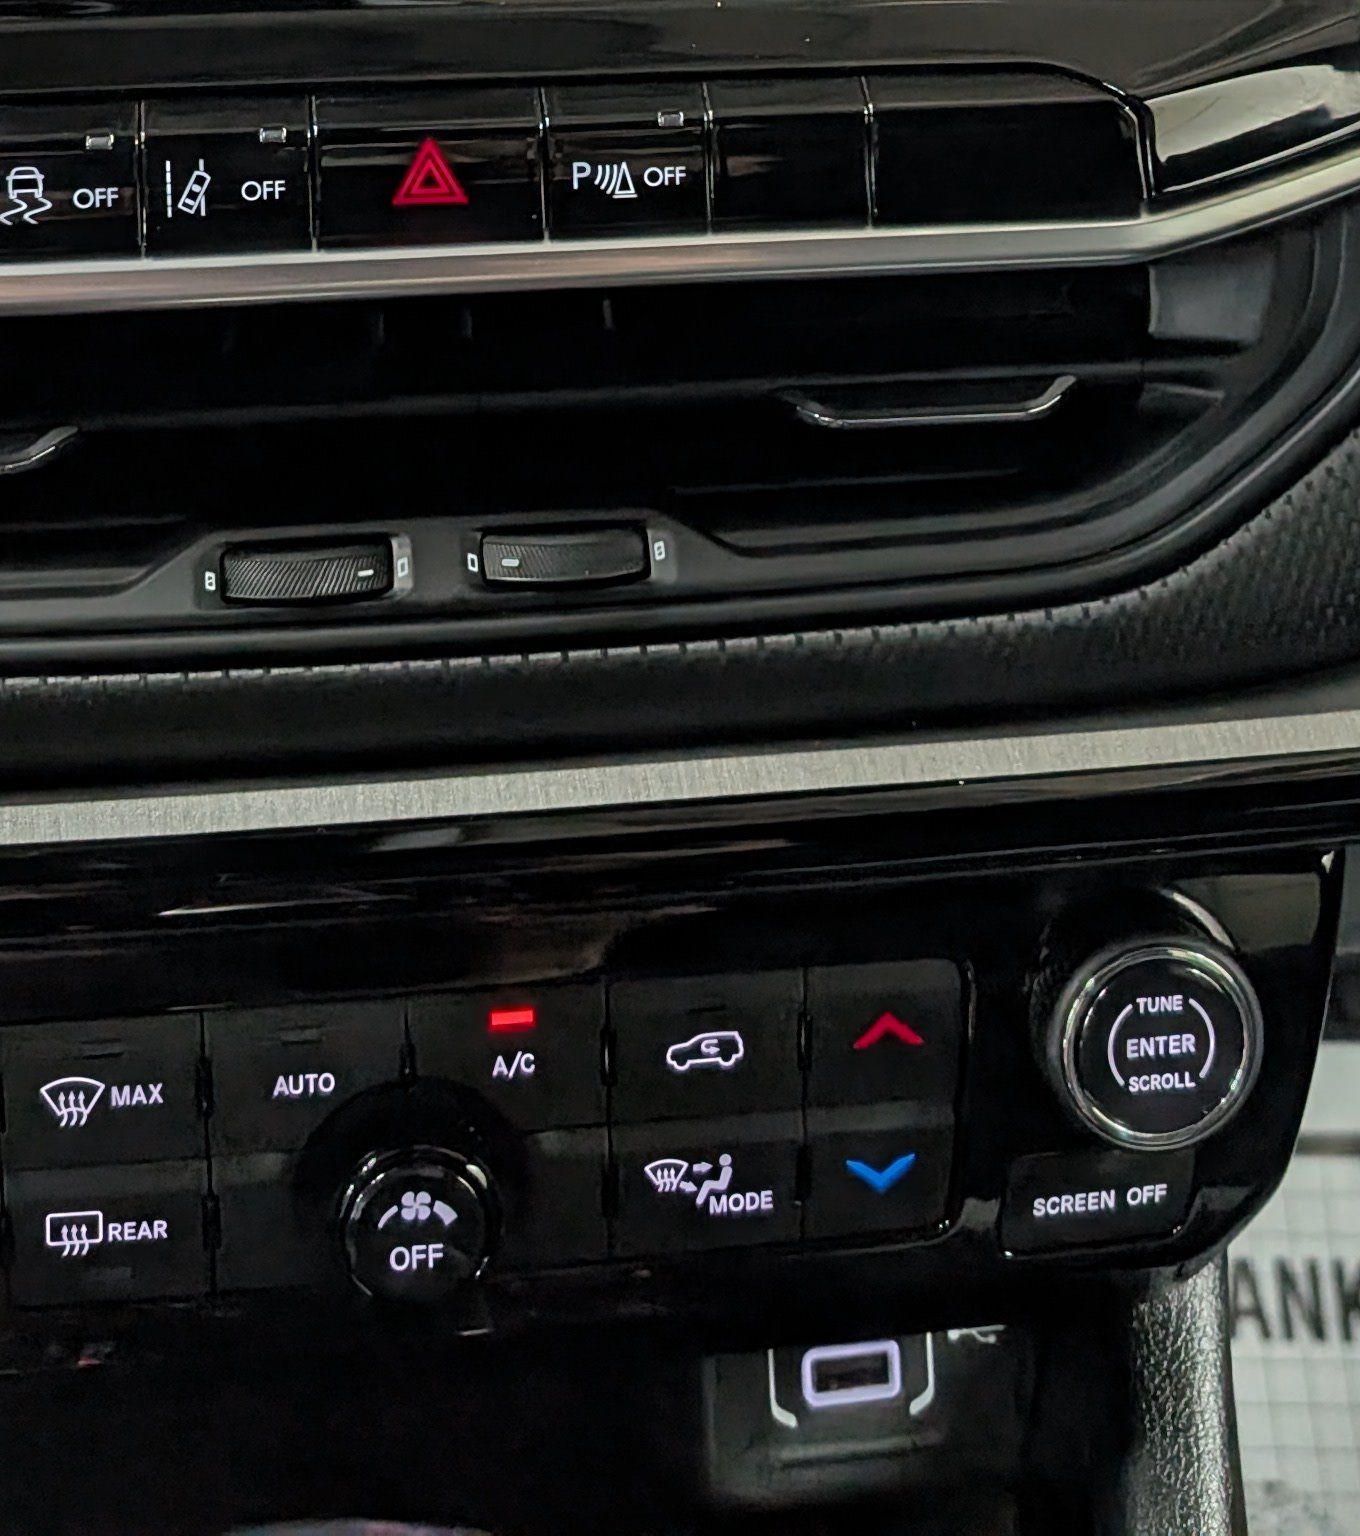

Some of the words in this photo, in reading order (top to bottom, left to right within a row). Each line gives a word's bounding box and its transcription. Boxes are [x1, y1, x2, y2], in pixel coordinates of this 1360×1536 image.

[643, 165, 687, 189] OFF
[72, 187, 120, 210] OFF
[241, 179, 287, 202] OFF
[1136, 994, 1184, 1015] TUNE
[1126, 1033, 1197, 1061] ENTER
[491, 1051, 536, 1079] A/C
[272, 1072, 336, 1098] AUTO
[1128, 1070, 1196, 1094] SCROLL
[110, 1083, 164, 1109] MAX
[708, 1190, 774, 1215] MODE
[1032, 1189, 1117, 1219] SCREEN
[1126, 1183, 1168, 1207] OFF
[107, 1220, 169, 1243] REAR
[389, 1243, 445, 1273] OFF
